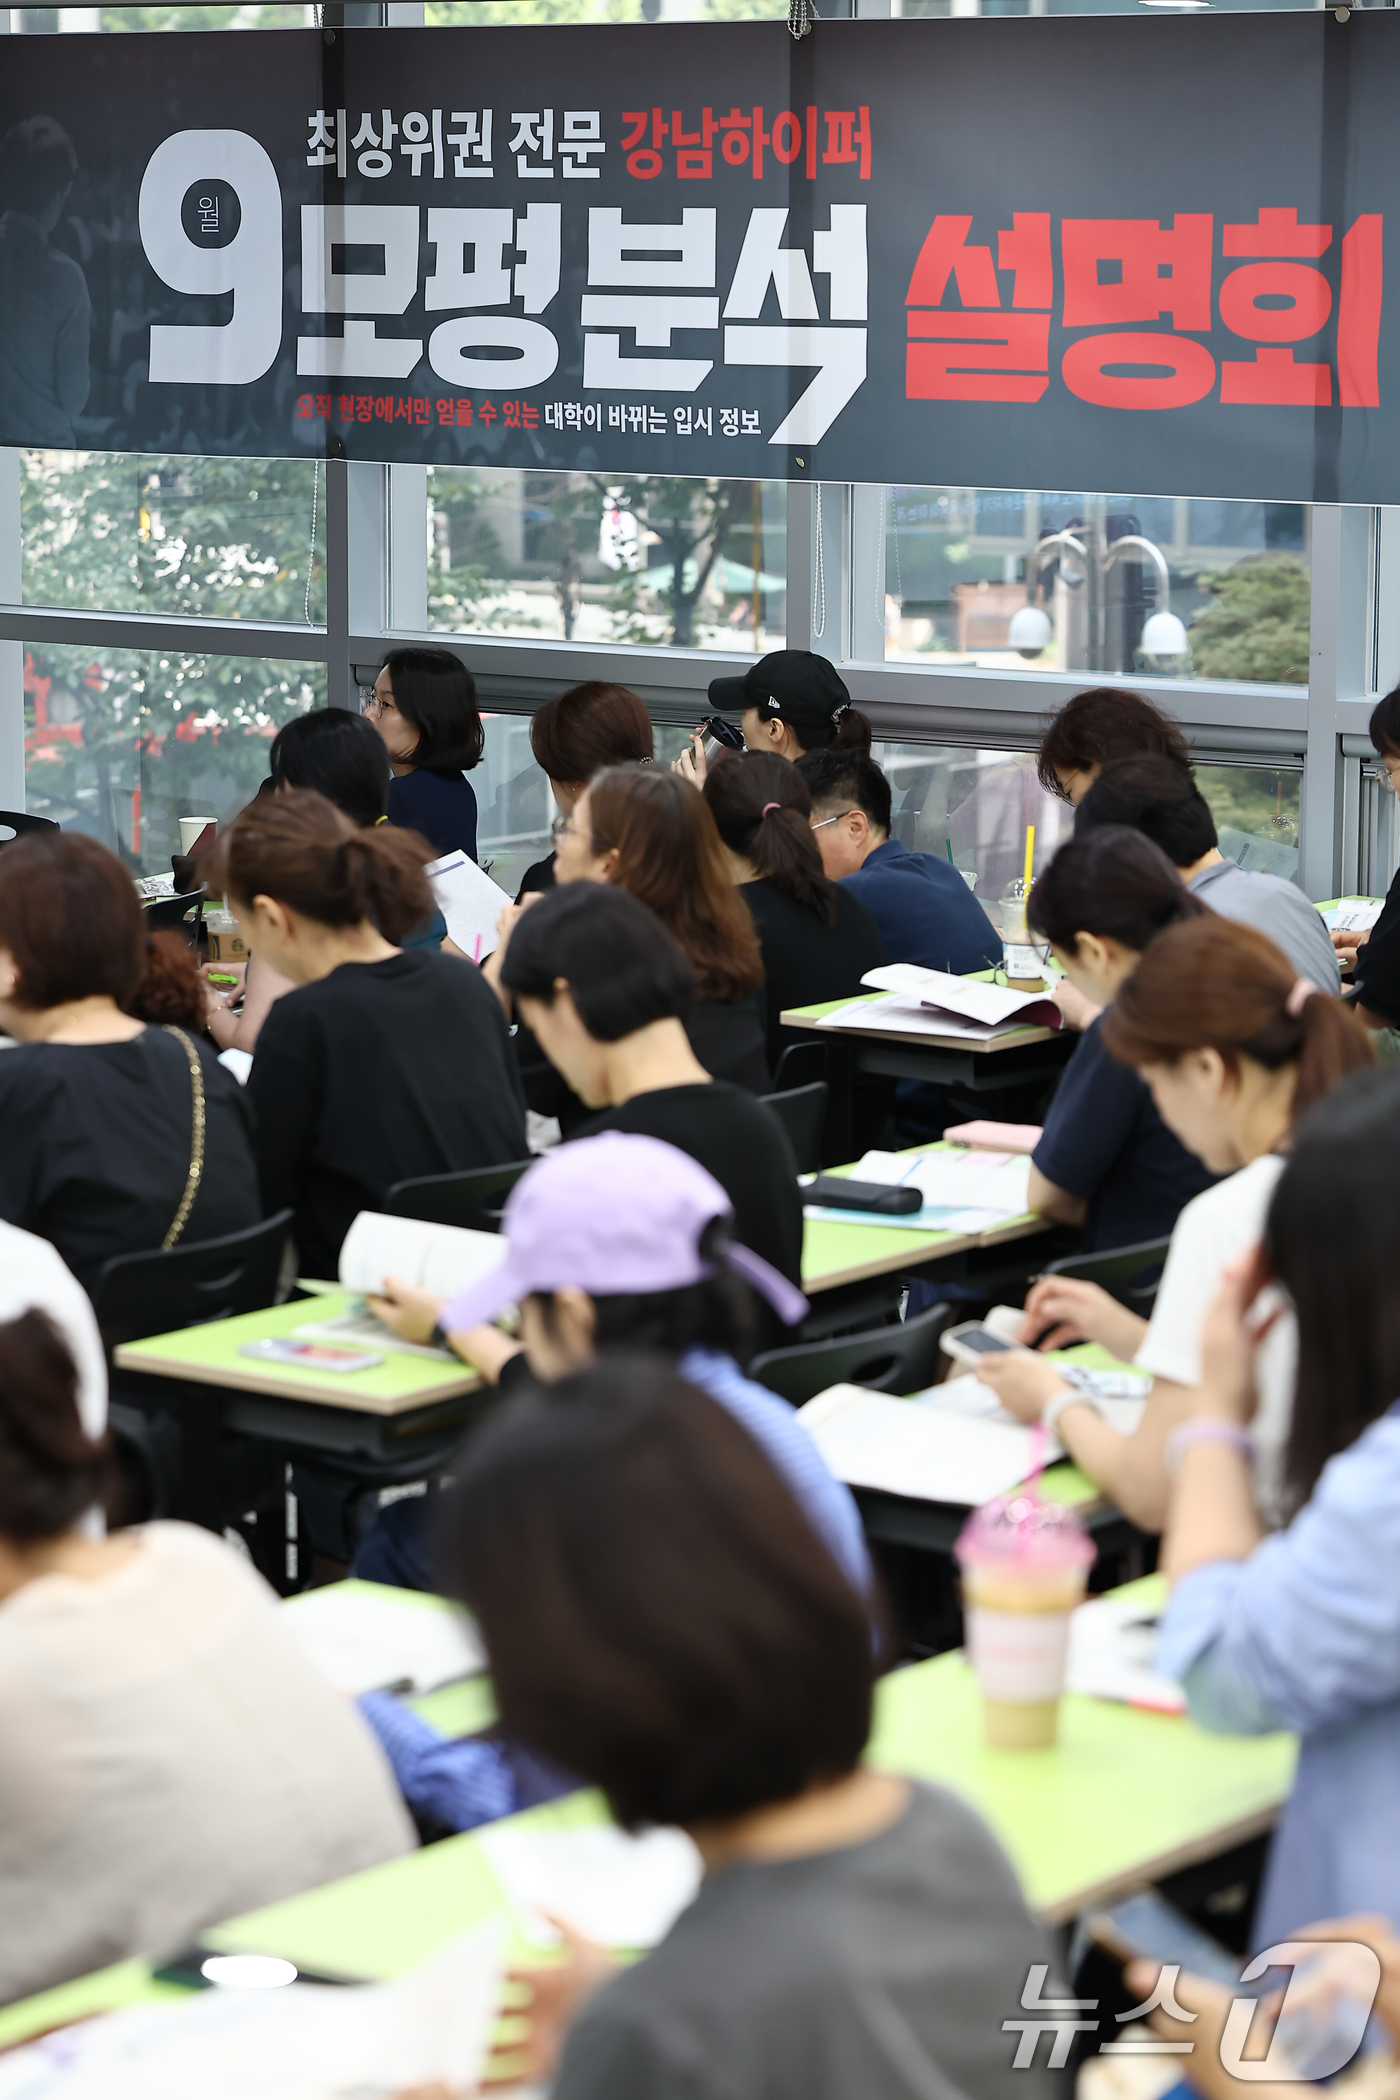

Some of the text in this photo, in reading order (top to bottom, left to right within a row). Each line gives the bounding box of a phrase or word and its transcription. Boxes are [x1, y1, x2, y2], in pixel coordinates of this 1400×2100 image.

[306, 105, 872, 180] 최상위권 전문 강남하이퍼
[138, 129, 1383, 446] 9 월 모평 분석 설명회
[296, 393, 762, 438] 오직 현장에서만 얻을 수 있는 대학이 바뀌는 입시 정보
